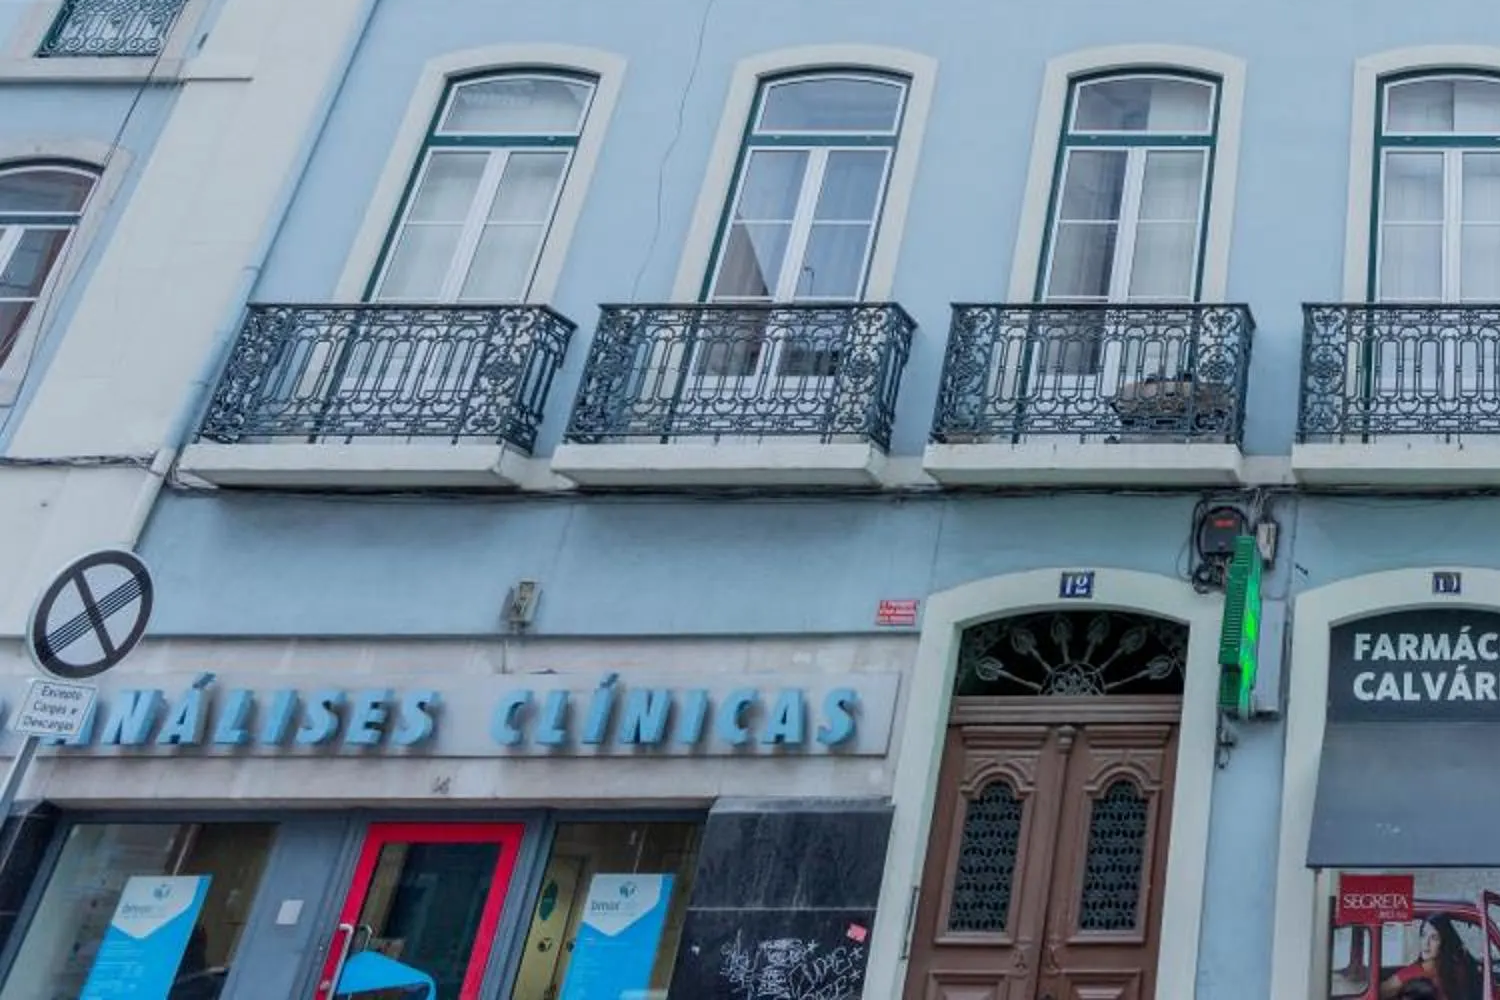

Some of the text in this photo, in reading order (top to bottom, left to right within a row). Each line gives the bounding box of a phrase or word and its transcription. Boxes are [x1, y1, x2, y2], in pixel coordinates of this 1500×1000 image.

[1065, 575, 1088, 595] 12
[491, 672, 861, 747] CLÍNICAS
[1343, 893, 1409, 909] SEGRETA
